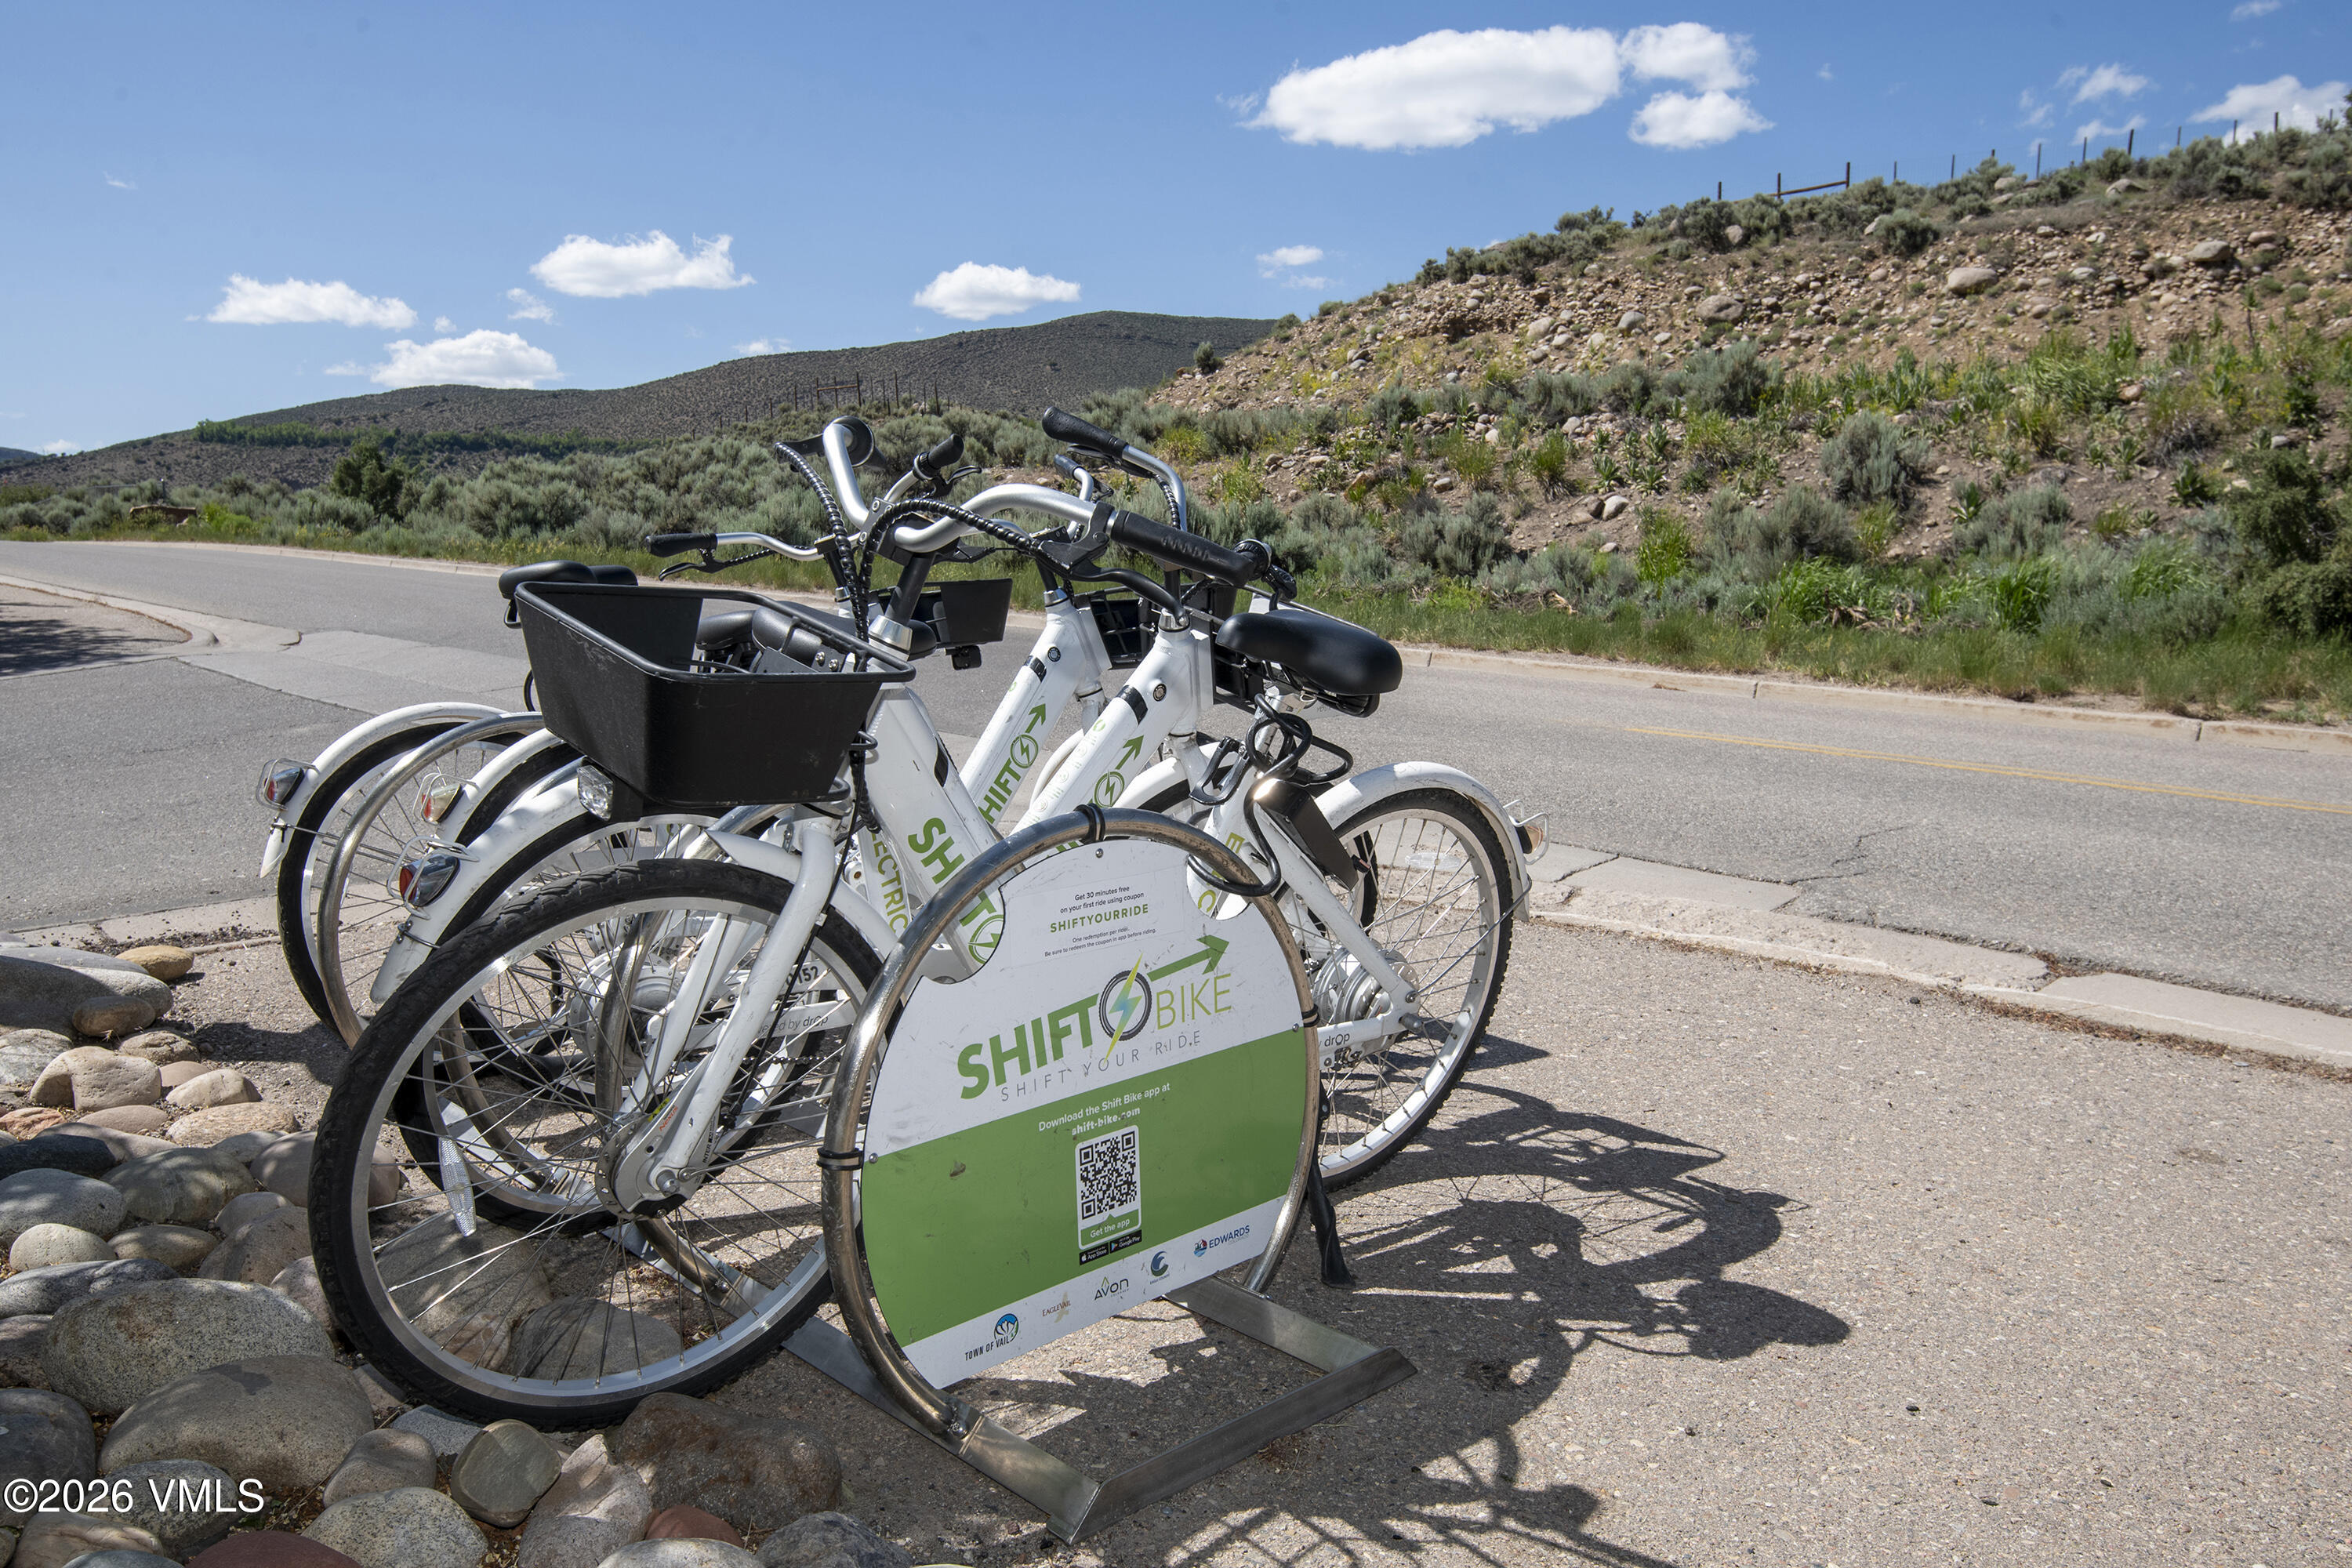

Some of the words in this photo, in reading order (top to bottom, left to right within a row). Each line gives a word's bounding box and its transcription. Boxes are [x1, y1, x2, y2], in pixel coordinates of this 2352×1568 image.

[978, 757, 1022, 825] HIFT
[908, 818, 997, 927] SHT
[1069, 904, 1082, 913] your
[1123, 892, 1145, 902] coupon
[1095, 888, 1118, 897] minutes
[1050, 903, 1149, 933] SHIFTYOURRIDE
[1083, 931, 1109, 941] redemption
[1095, 938, 1112, 946] coupon
[788, 1018, 801, 1031] by
[957, 993, 1099, 1099] SHIFT
[1156, 973, 1232, 1030] BIKE
[1001, 1069, 1066, 1102] SHIFT
[1083, 1049, 1139, 1075] YOUR
[1156, 1030, 1200, 1055] RIDE
[1039, 1109, 1083, 1131] Download
[1085, 1105, 1100, 1116] the
[1102, 1097, 1122, 1111] Shift
[1123, 1092, 1142, 1105] Bike
[1144, 1087, 1160, 1098] app
[1161, 1083, 1171, 1092] at
[1091, 1228, 1103, 1238] Get
[1104, 1224, 1116, 1233] the
[1117, 1219, 1130, 1229] app
[1209, 1225, 1250, 1249] EDWARDS
[965, 1345, 984, 1361] TOWN
[985, 1341, 995, 1352] OF
[996, 1335, 1010, 1348] VAIL
